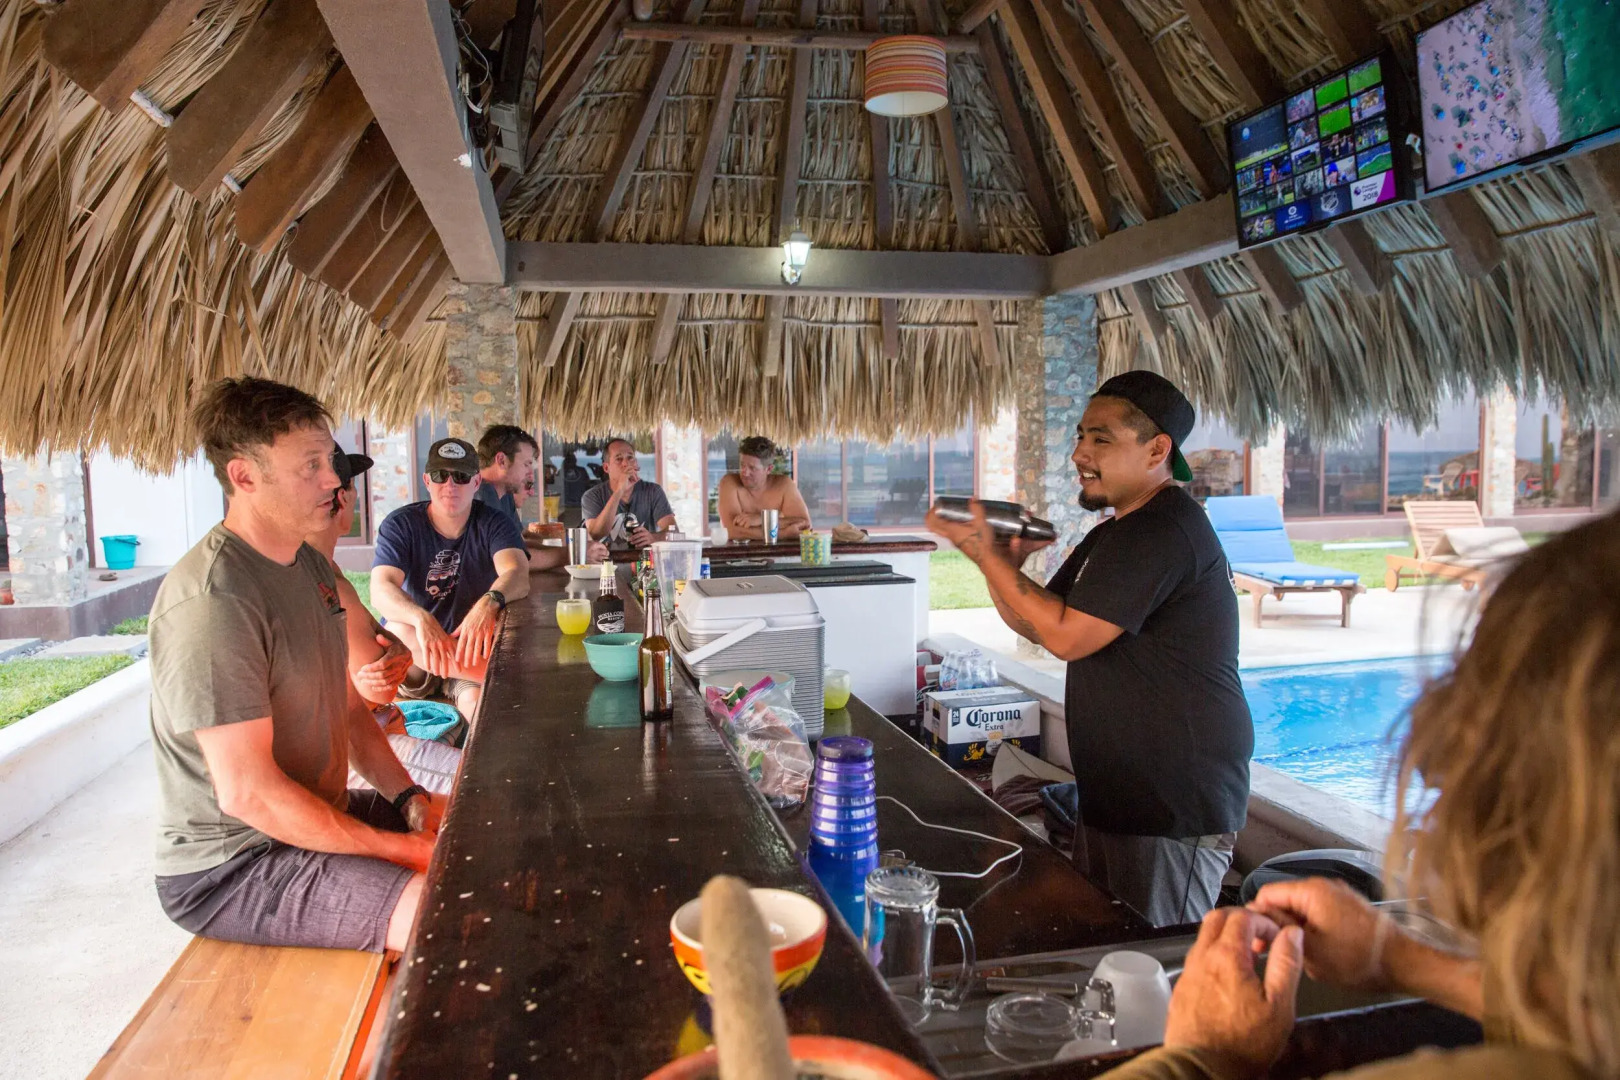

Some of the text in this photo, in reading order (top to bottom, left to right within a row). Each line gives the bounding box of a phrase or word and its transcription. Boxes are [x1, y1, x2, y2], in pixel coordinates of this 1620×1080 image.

[953, 710, 960, 718] 24
[966, 708, 1021, 728] Corona
[985, 723, 1004, 731] Extra
